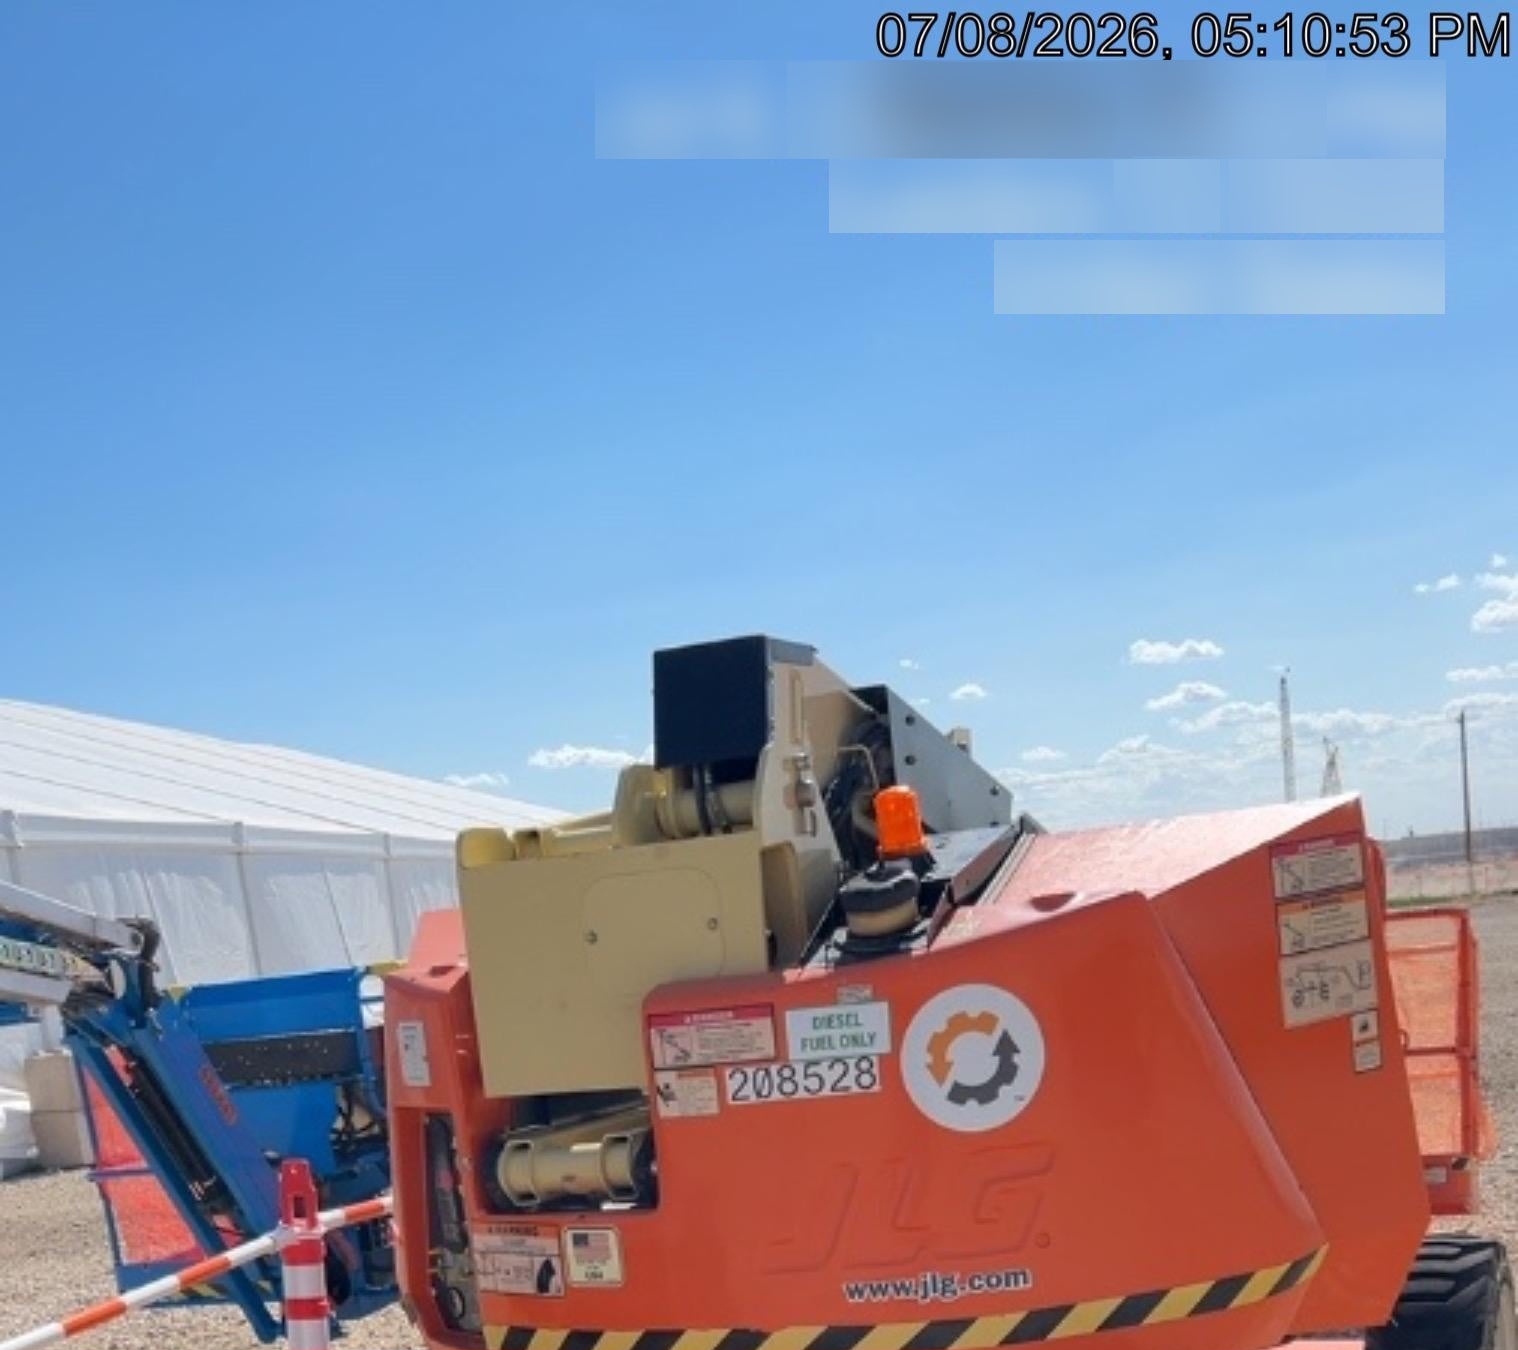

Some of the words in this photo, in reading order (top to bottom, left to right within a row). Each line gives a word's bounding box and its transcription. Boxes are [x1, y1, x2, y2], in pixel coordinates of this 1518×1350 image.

[812, 1013, 864, 1030] DIESEL
[801, 1035, 837, 1051] FUEL
[840, 1031, 876, 1048] ONLY
[728, 1055, 877, 1101] 208528
[844, 1269, 1031, 1301] www.jlg.com
